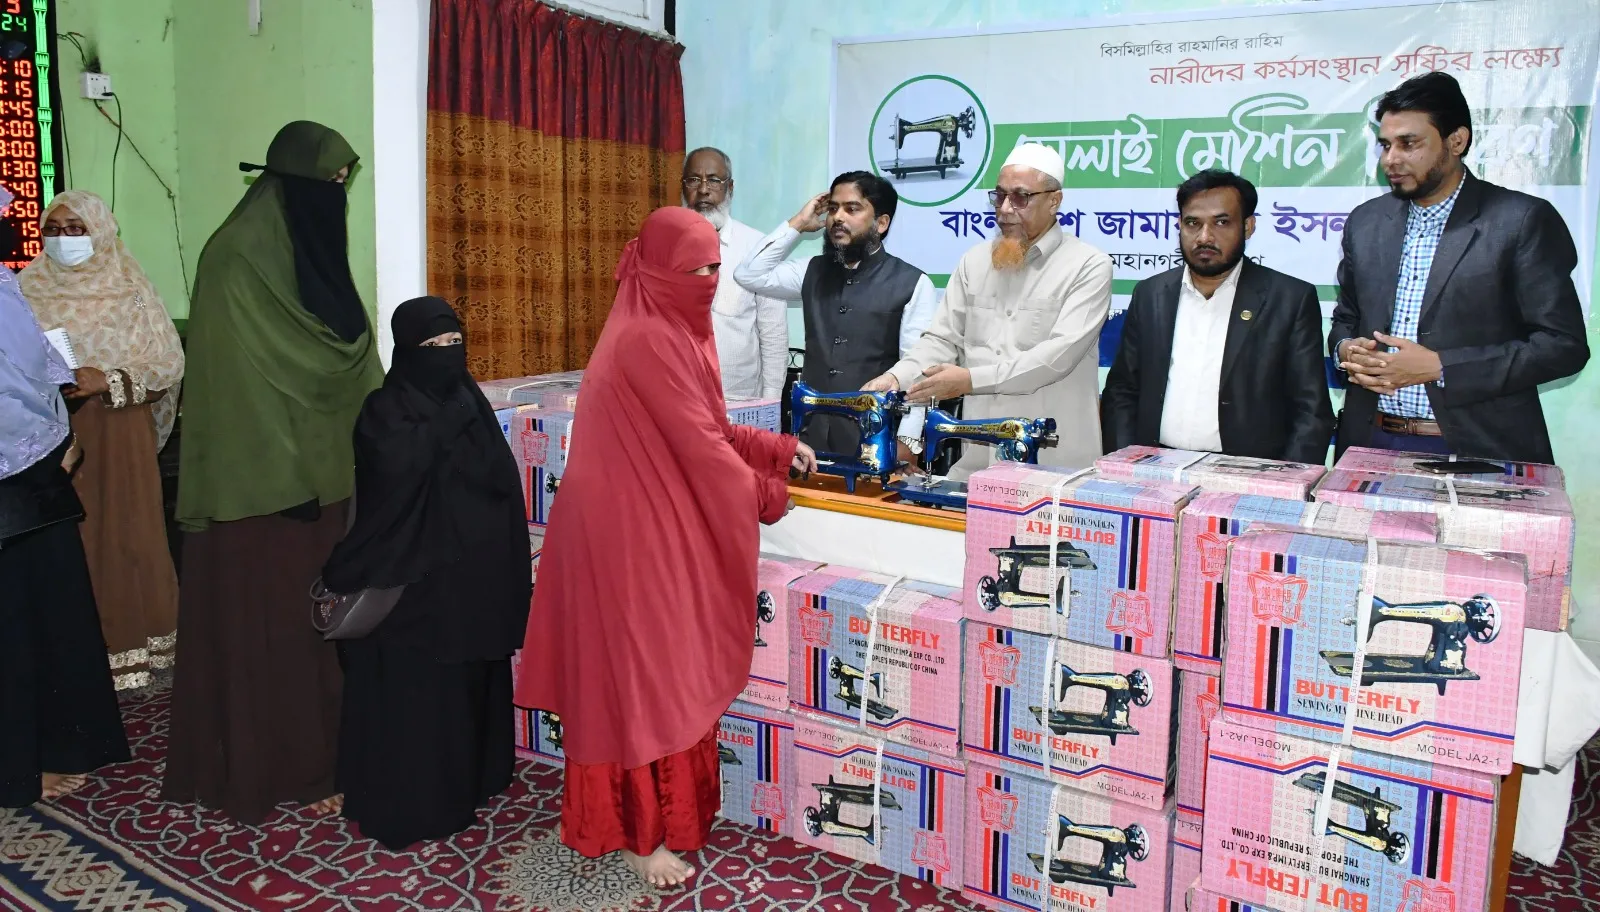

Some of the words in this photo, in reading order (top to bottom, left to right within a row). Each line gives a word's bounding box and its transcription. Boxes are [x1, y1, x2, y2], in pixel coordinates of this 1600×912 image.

[1100, 42, 1173, 58] বিসমিল্লাহির
[1178, 36, 1239, 53] রাহমানির
[1244, 33, 1285, 49] রাহিম
[1149, 58, 1246, 85] নারীদের
[1254, 54, 1381, 82] কর্মসংস্থান
[1391, 45, 1474, 79] সৃষ্টির
[1000, 486, 1029, 498] MODEL
[848, 616, 941, 650] BUTERFLY
[742, 689, 764, 699] ODEL
[1296, 679, 1421, 715] BUTTERFLY
[1297, 698, 1332, 713] SEWING
[1335, 704, 1376, 721] MAINE
[1377, 712, 1404, 726] HEAD
[1220, 730, 1249, 743] JA2-1
[1251, 736, 1291, 752] MODEL
[1039, 748, 1069, 762] CHINE
[1417, 744, 1462, 760] MODEL
[1466, 753, 1501, 766] JA2-1
[1097, 781, 1127, 796] MODEL
[1231, 827, 1255, 841] CHINA
[1256, 833, 1265, 842] OF
[1268, 837, 1304, 852] REPUBLIC
[1306, 846, 1342, 864] PEOP'S
[1344, 858, 1359, 868] THE
[1287, 858, 1330, 876] BUERFLY
[1331, 867, 1370, 888] SHANGHAI
[1011, 872, 1097, 909] BUTERFLY
